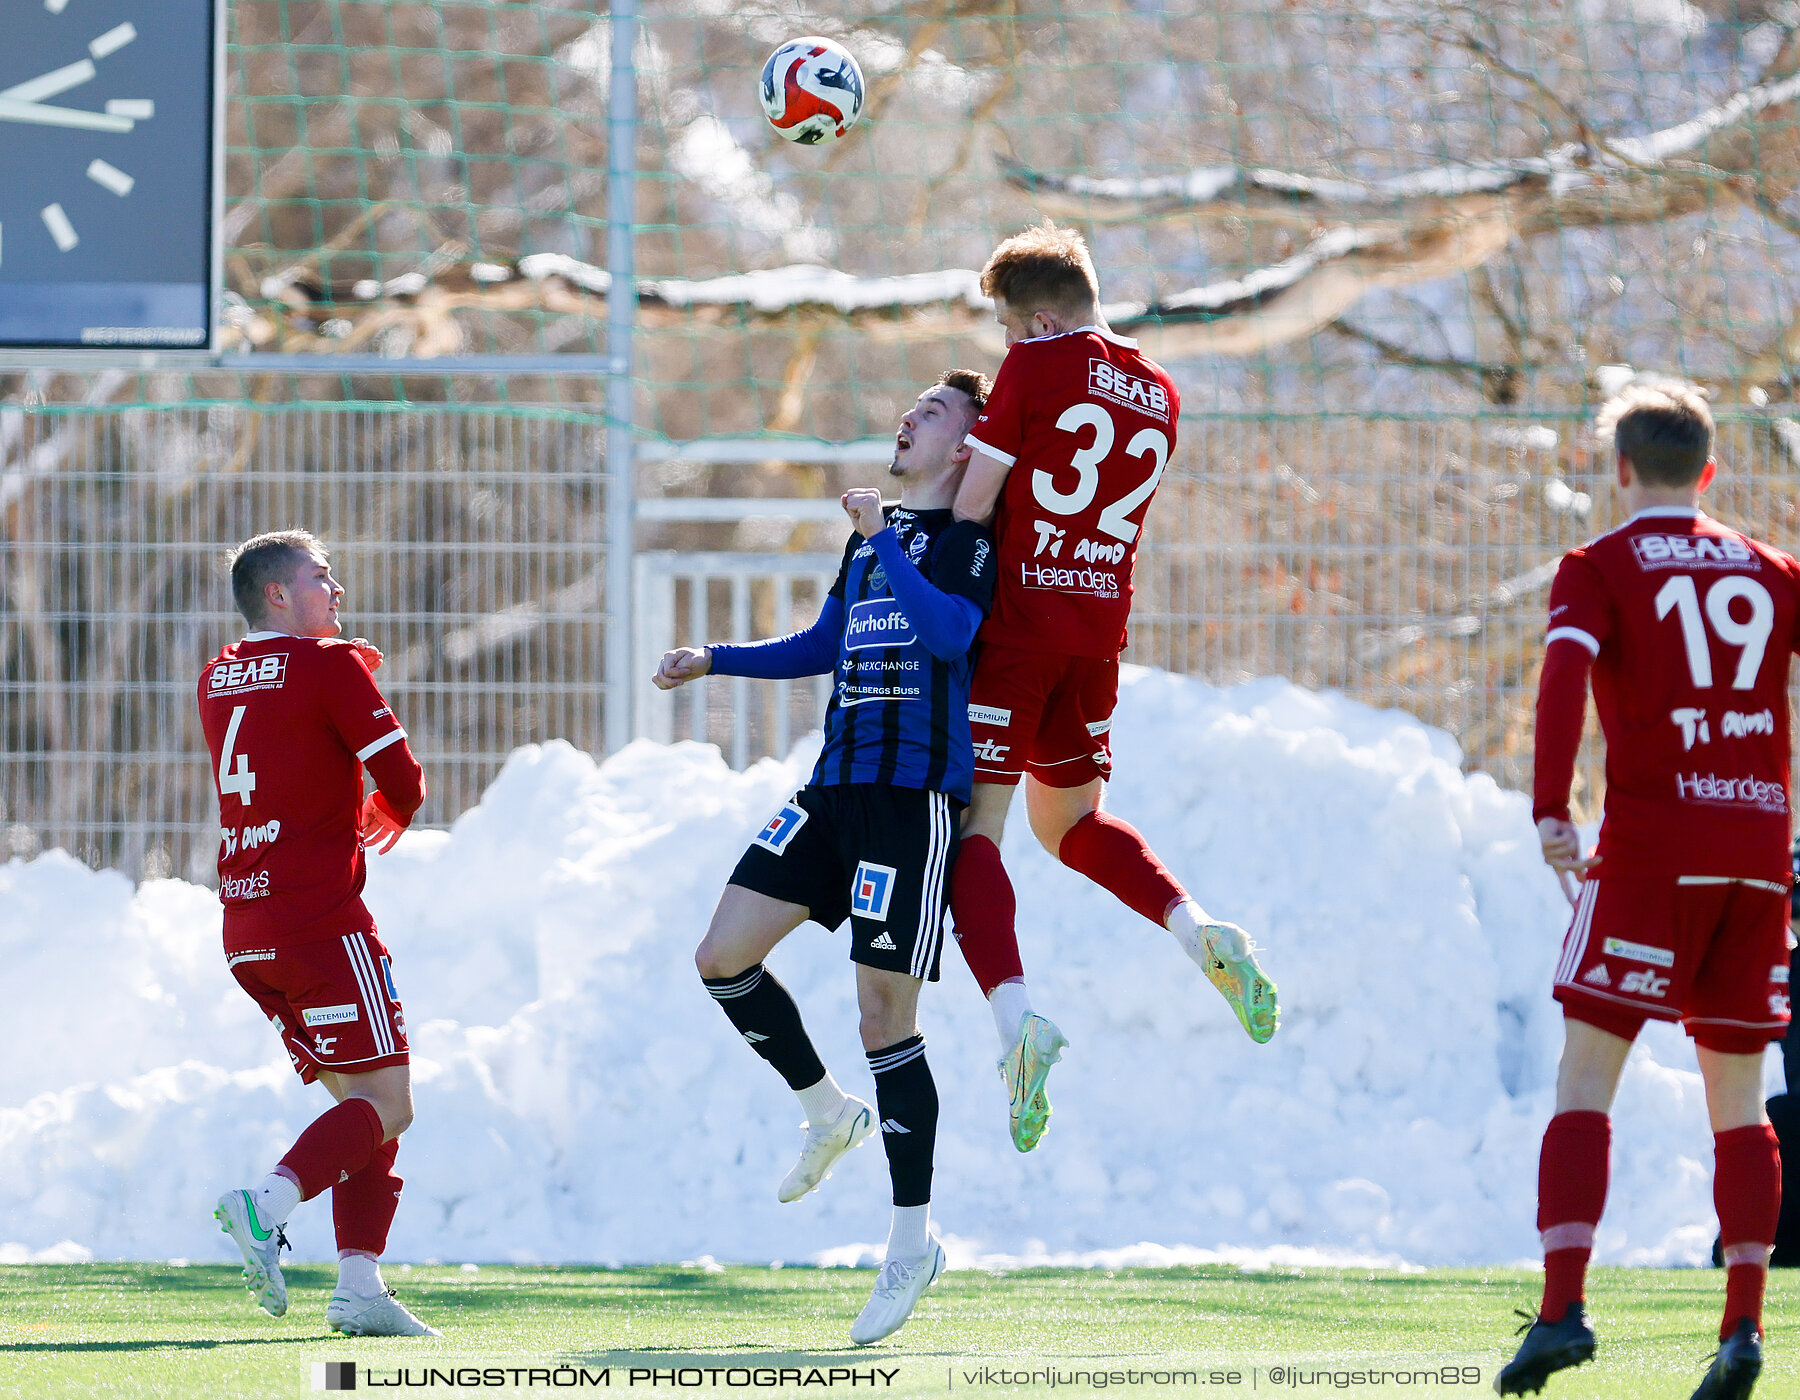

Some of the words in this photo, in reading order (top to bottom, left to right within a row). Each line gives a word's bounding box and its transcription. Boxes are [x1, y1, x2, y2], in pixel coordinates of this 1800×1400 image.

[1096, 364, 1166, 412] SEAB
[1032, 403, 1168, 544] 32
[1034, 520, 1066, 557] Ti
[1640, 536, 1750, 561] SEAB
[1021, 563, 1118, 590] Helanders
[849, 612, 910, 635] Furhoffs
[1656, 575, 1774, 690] 19
[211, 657, 279, 689] SEAB
[968, 710, 1008, 723] CTEMIUM
[1670, 708, 1711, 751] Ti
[219, 705, 256, 806] 4
[1675, 772, 1786, 803] Helanders
[220, 827, 238, 861] Ti
[870, 940, 897, 951] adidas
[1618, 968, 1671, 998] stc
[312, 1011, 356, 1021] ACTEMIUM
